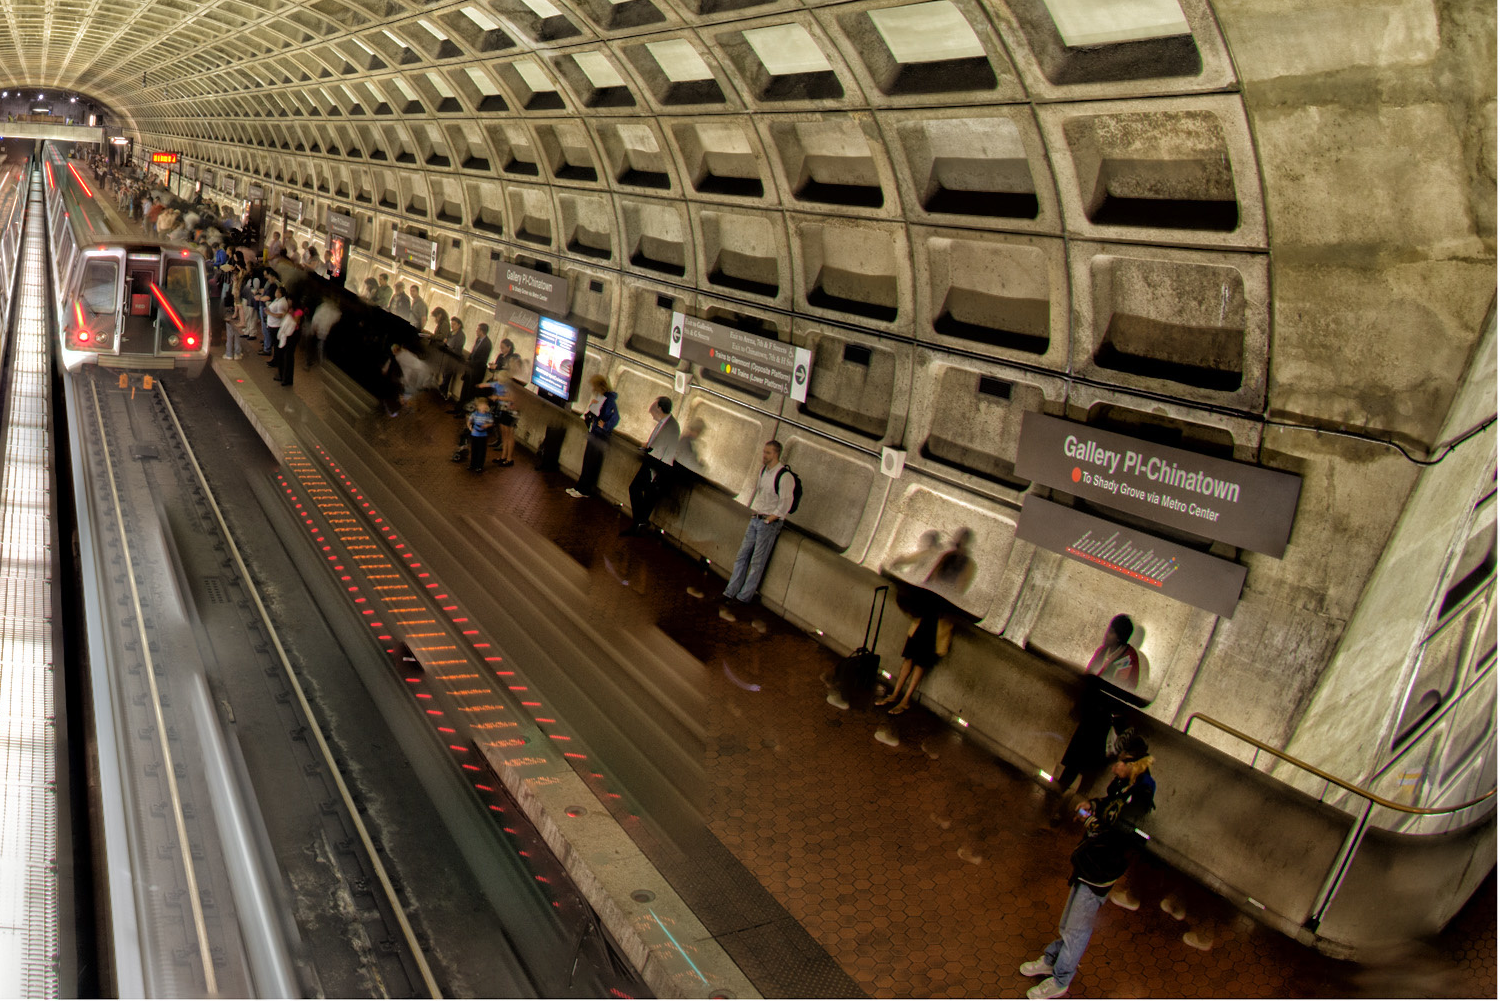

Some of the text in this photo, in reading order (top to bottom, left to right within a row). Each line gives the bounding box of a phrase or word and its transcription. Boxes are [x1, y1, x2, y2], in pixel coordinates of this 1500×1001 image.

[507, 269, 521, 285] Gallery
[730, 331, 738, 339] Exit
[732, 342, 740, 351] Exit
[715, 350, 726, 361] Trains
[731, 355, 751, 368] Glenmont
[751, 362, 771, 375] (Opposite
[771, 369, 791, 383] Platform)
[737, 368, 749, 379] Trains
[749, 373, 764, 383] (Lower
[764, 378, 784, 392] Platform)
[1064, 435, 1240, 503] Gallery Pl-Chinatown
[1082, 471, 1220, 522] To Shady Grove via Metro Center
